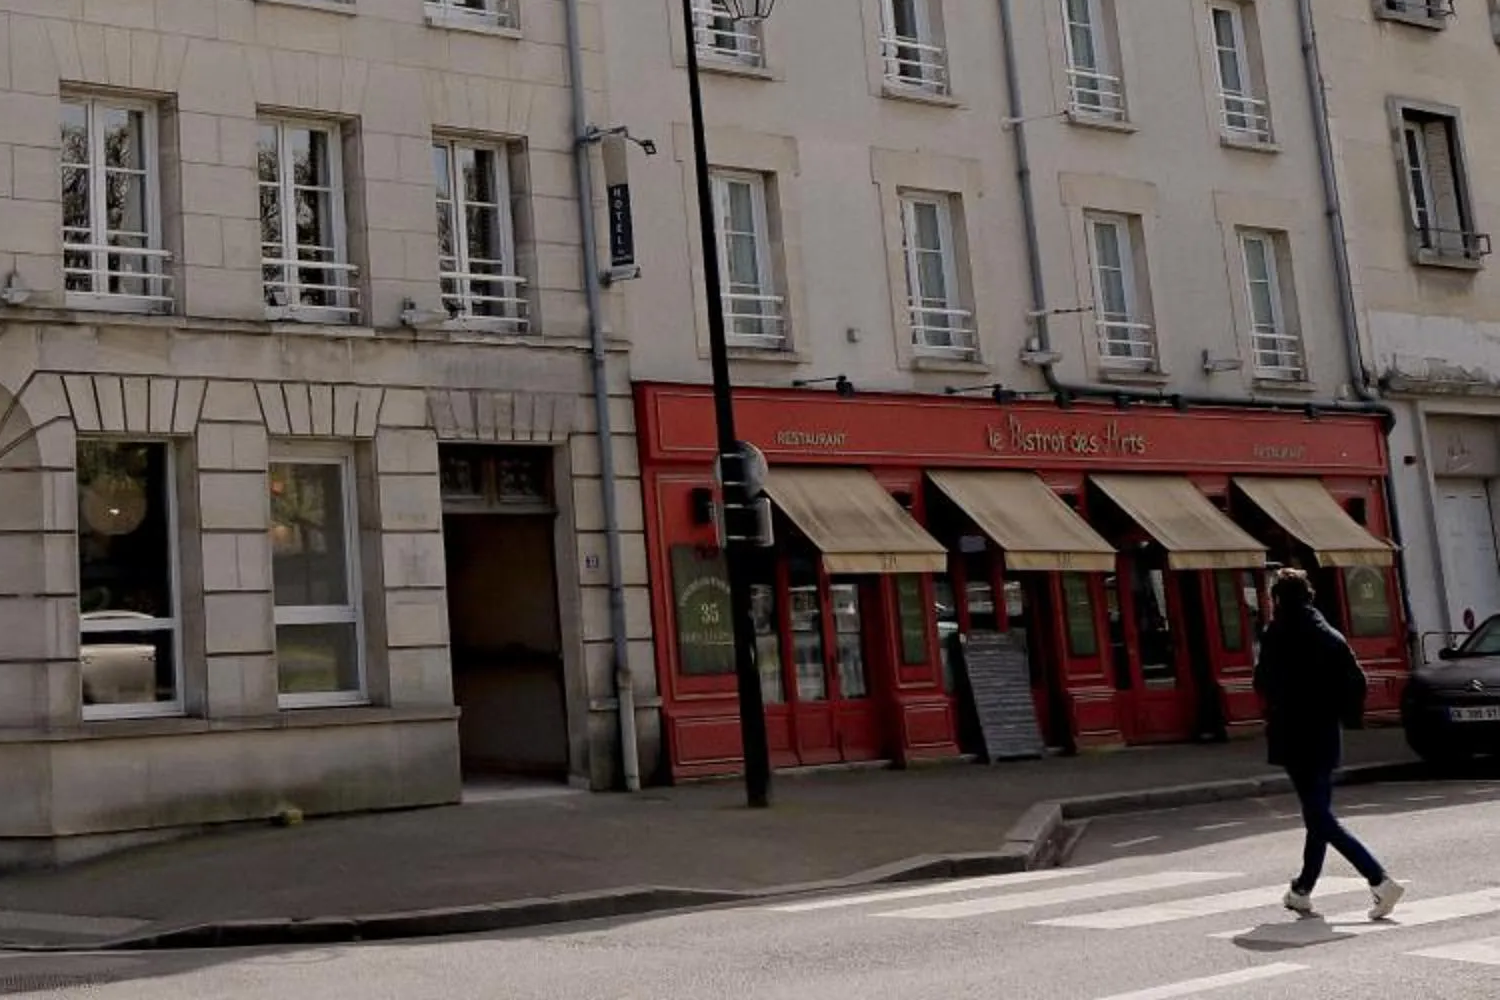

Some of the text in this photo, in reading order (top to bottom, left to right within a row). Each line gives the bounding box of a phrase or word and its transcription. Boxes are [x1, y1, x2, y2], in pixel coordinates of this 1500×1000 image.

[612, 187, 625, 245] HOTEL
[776, 430, 846, 445] RESTAURANT
[1070, 426, 1099, 453] des
[700, 603, 720, 624] 35
